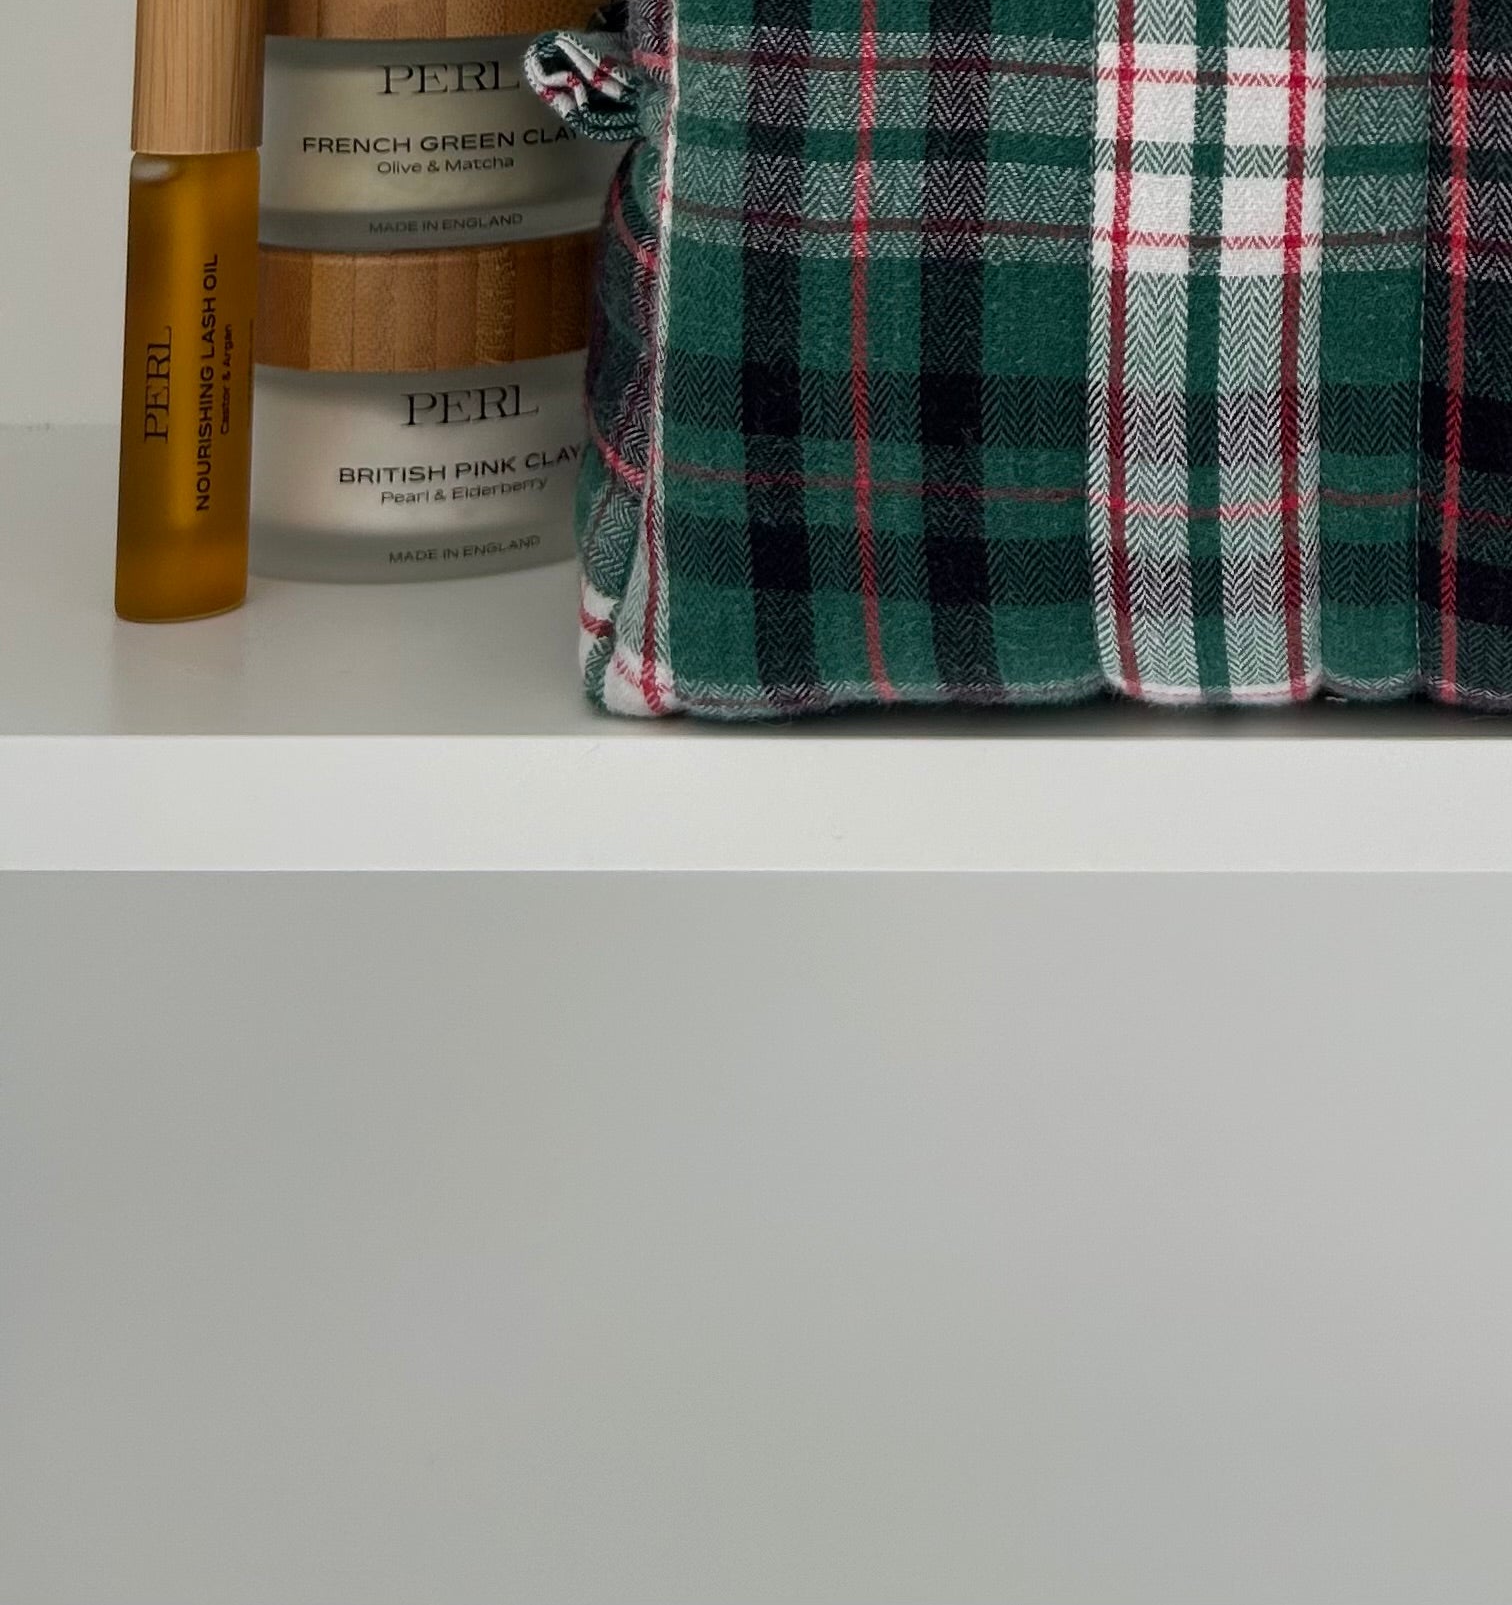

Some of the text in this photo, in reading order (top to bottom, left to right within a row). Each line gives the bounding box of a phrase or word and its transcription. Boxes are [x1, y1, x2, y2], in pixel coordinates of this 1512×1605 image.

[377, 60, 520, 95] PERL
[302, 136, 411, 154] FRENCH
[420, 131, 514, 151] GREEN
[377, 156, 514, 175] Olive & Matcha
[369, 213, 523, 235] MADE IN ENGLAND
[223, 324, 233, 368] Argan
[144, 325, 172, 444] PERL
[196, 254, 219, 512] NOURISHING LASH OIL
[401, 384, 539, 427] PERL
[339, 465, 446, 485] BRITISH
[455, 456, 516, 480] PINK
[381, 475, 548, 505] Pearl & Elderberry
[389, 534, 540, 564] MADE IN ENGLAND
